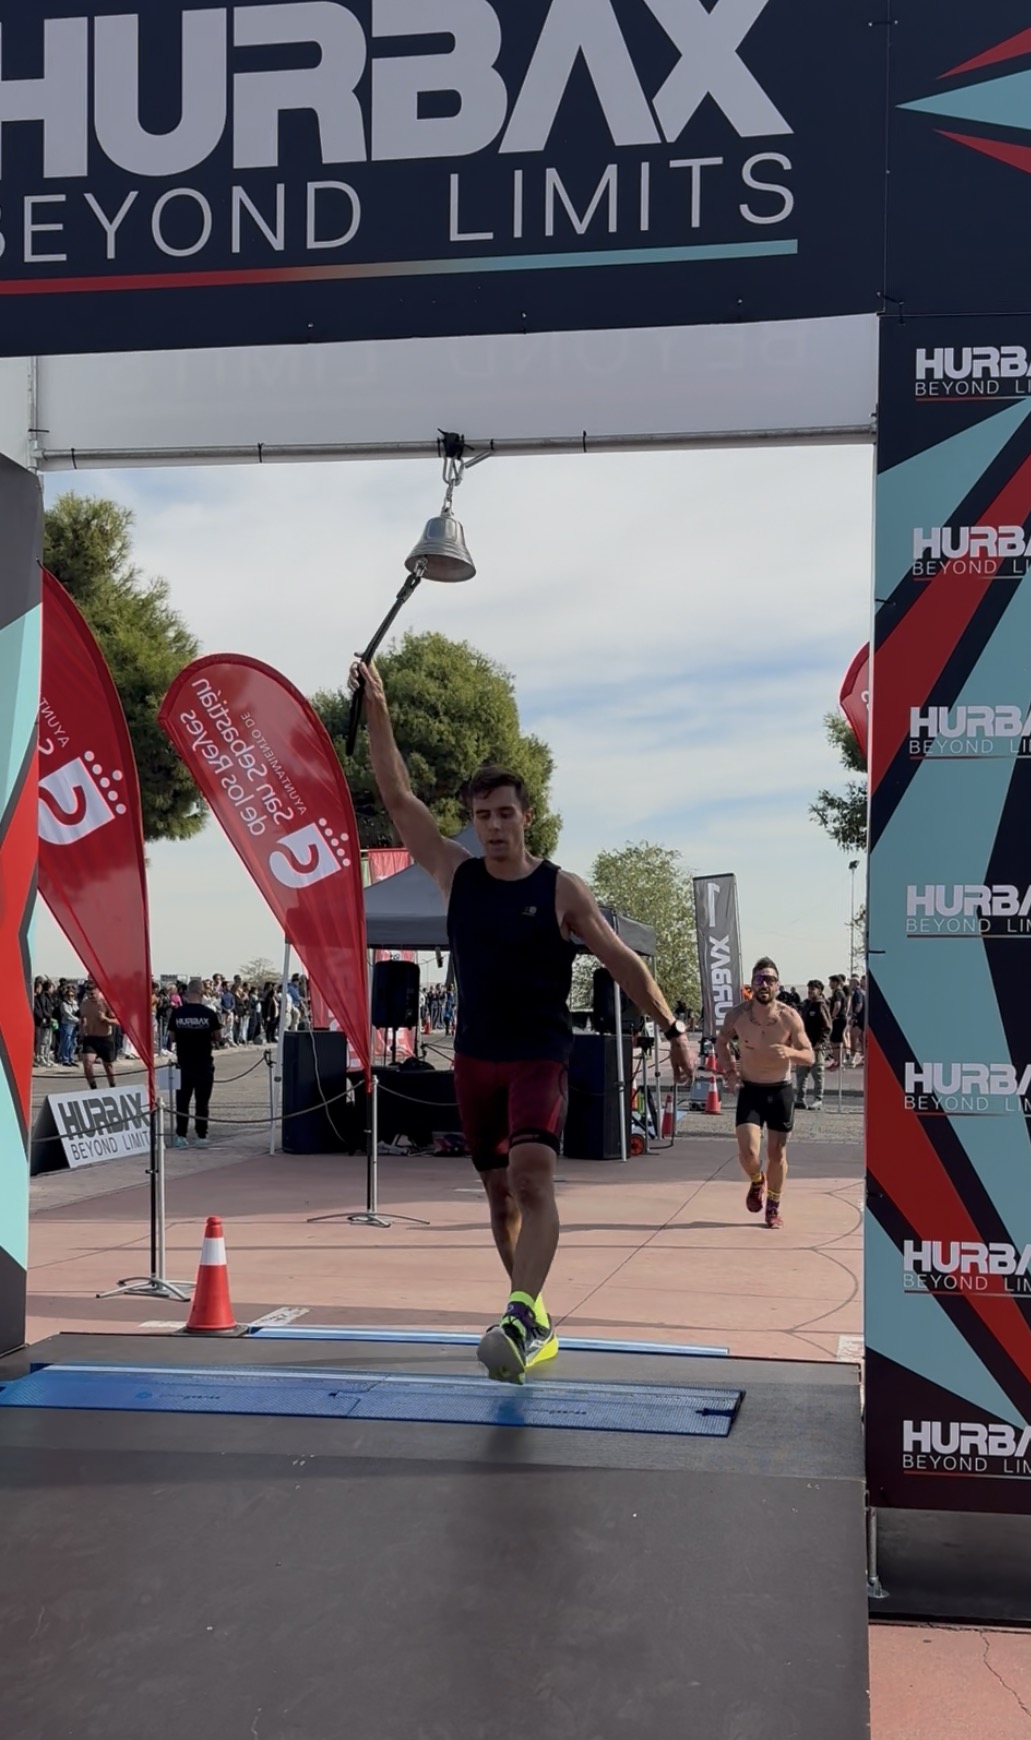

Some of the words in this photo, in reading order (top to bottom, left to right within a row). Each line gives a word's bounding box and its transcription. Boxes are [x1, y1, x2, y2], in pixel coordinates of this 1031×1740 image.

[0, 0, 795, 178] HURBAX
[0, 181, 362, 263] EYOND
[449, 152, 795, 242] LIMITS
[915, 345, 1031, 380] HURB
[915, 380, 1000, 396] BEYOND
[913, 525, 1031, 559] HURB
[912, 560, 997, 576] BEYOND
[909, 739, 994, 755] BEYOND
[905, 918, 991, 933] BEYOND
[904, 1095, 989, 1111] BEYOND
[57, 1092, 151, 1141] HURBAX
[70, 1136, 119, 1161] BEYOND
[121, 1130, 151, 1151] LIMIT
[903, 1273, 988, 1291] BEYOND
[902, 1454, 988, 1473] BEYOND
